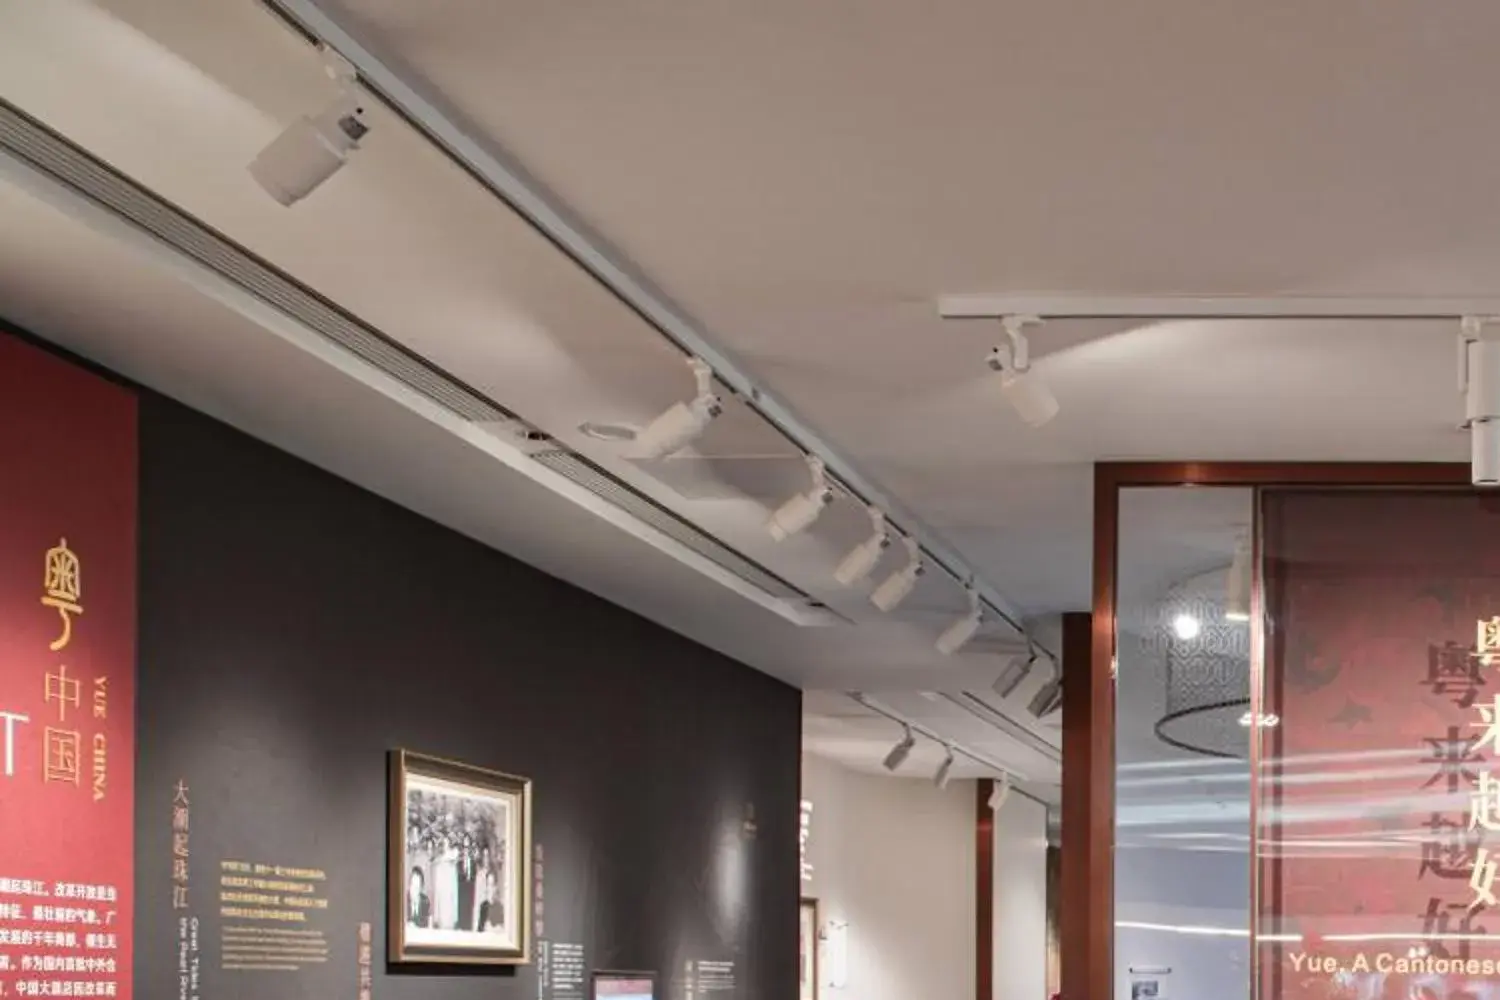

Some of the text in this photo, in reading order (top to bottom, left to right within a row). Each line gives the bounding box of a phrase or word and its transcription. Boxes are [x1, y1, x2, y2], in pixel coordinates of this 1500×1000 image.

[92, 675, 107, 802] YUE CHINA
[1288, 952, 1345, 975] Yue,
[1351, 953, 1370, 973] A
